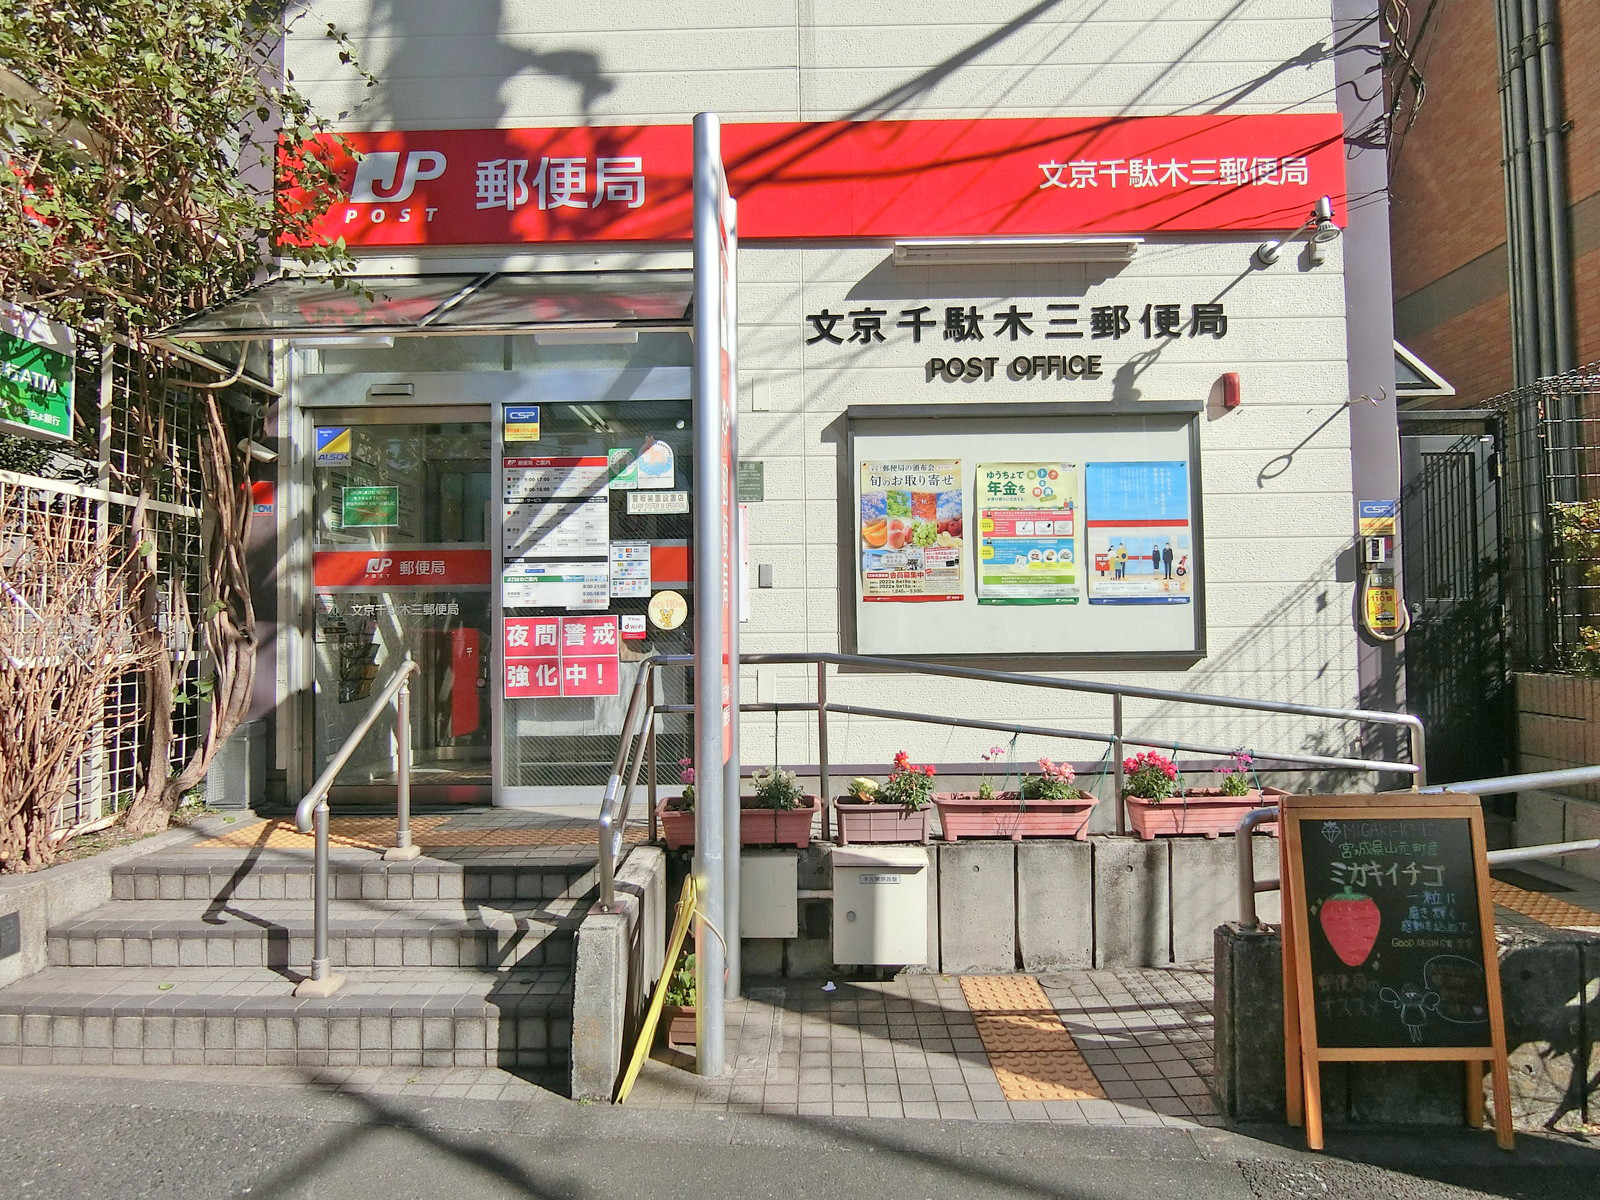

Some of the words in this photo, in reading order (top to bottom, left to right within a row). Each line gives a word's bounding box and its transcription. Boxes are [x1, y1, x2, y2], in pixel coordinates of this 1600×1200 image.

[1038, 158, 1309, 189] 文京千駄木三郵便局
[475, 157, 646, 211] 郵便局
[345, 207, 439, 223] POST
[806, 303, 1228, 345] 文京千駄木三郵便局
[931, 356, 999, 378] POST
[1012, 354, 1104, 376] OFFICE
[510, 411, 535, 419] CSP
[318, 453, 349, 461] ALSOK
[870, 474, 954, 487] 旬のお取り寄せ
[987, 471, 1025, 479] ゆうちょで
[987, 481, 1026, 496] 年金を
[1364, 505, 1391, 514] CSP
[399, 560, 446, 576] 郵便局
[1338, 841, 1440, 859] 宮城県山元町産
[1329, 860, 1446, 887] ミガキイチゴ
[1406, 889, 1456, 904] 一粒に
